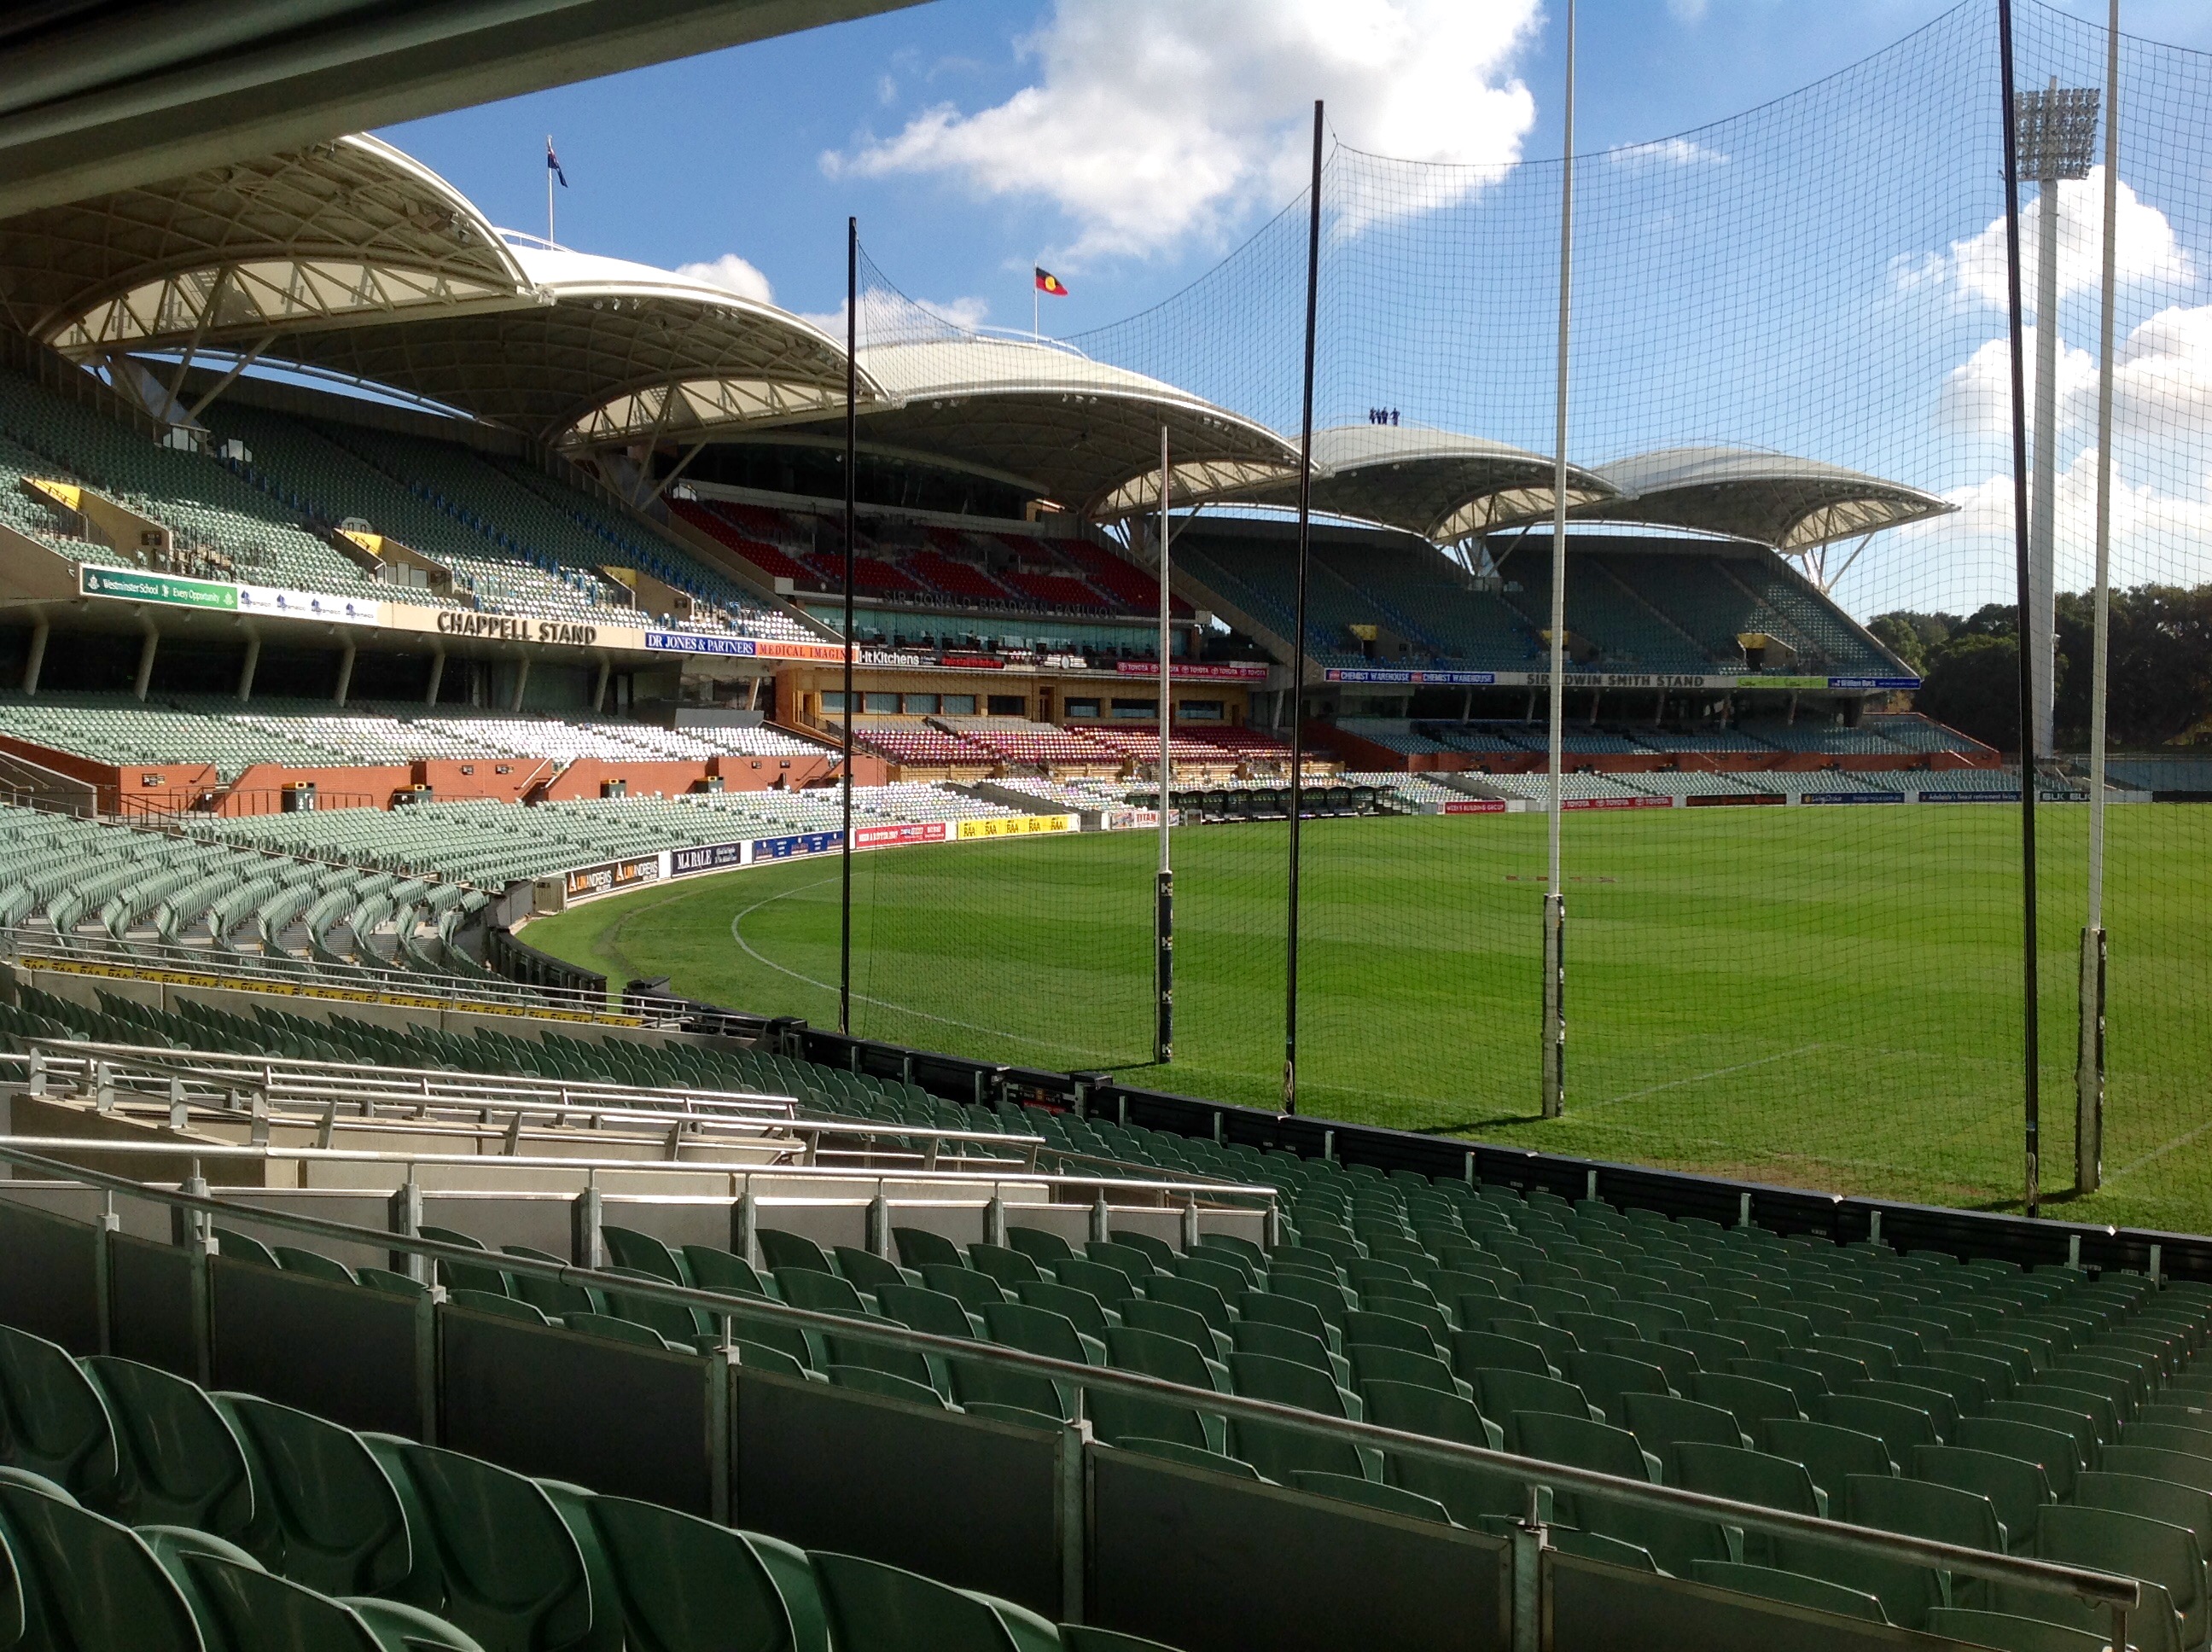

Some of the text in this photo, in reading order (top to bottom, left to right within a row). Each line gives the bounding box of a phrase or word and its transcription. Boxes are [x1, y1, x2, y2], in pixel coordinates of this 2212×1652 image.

[103, 579, 159, 596] Westminster School
[437, 611, 597, 645] CHAPPELL STAND
[649, 634, 754, 654] DR JONES & PARTNERS
[760, 643, 847, 661] MEDICAL IMAGIN
[873, 650, 919, 666] Kitchens
[1341, 672, 1369, 680] CHEMIST
[1371, 672, 1410, 682] WAREHOUSE
[1452, 674, 1493, 683] WAREHOUSE
[1528, 674, 1706, 688] SIR DWIN SMITH STAND
[1137, 813, 1156, 822] TITAN
[963, 825, 975, 837] RAA
[986, 823, 997, 835] RAA
[1007, 823, 1019, 834] RAA
[1029, 822, 1040, 833] RAA
[1051, 821, 1063, 831] RAA
